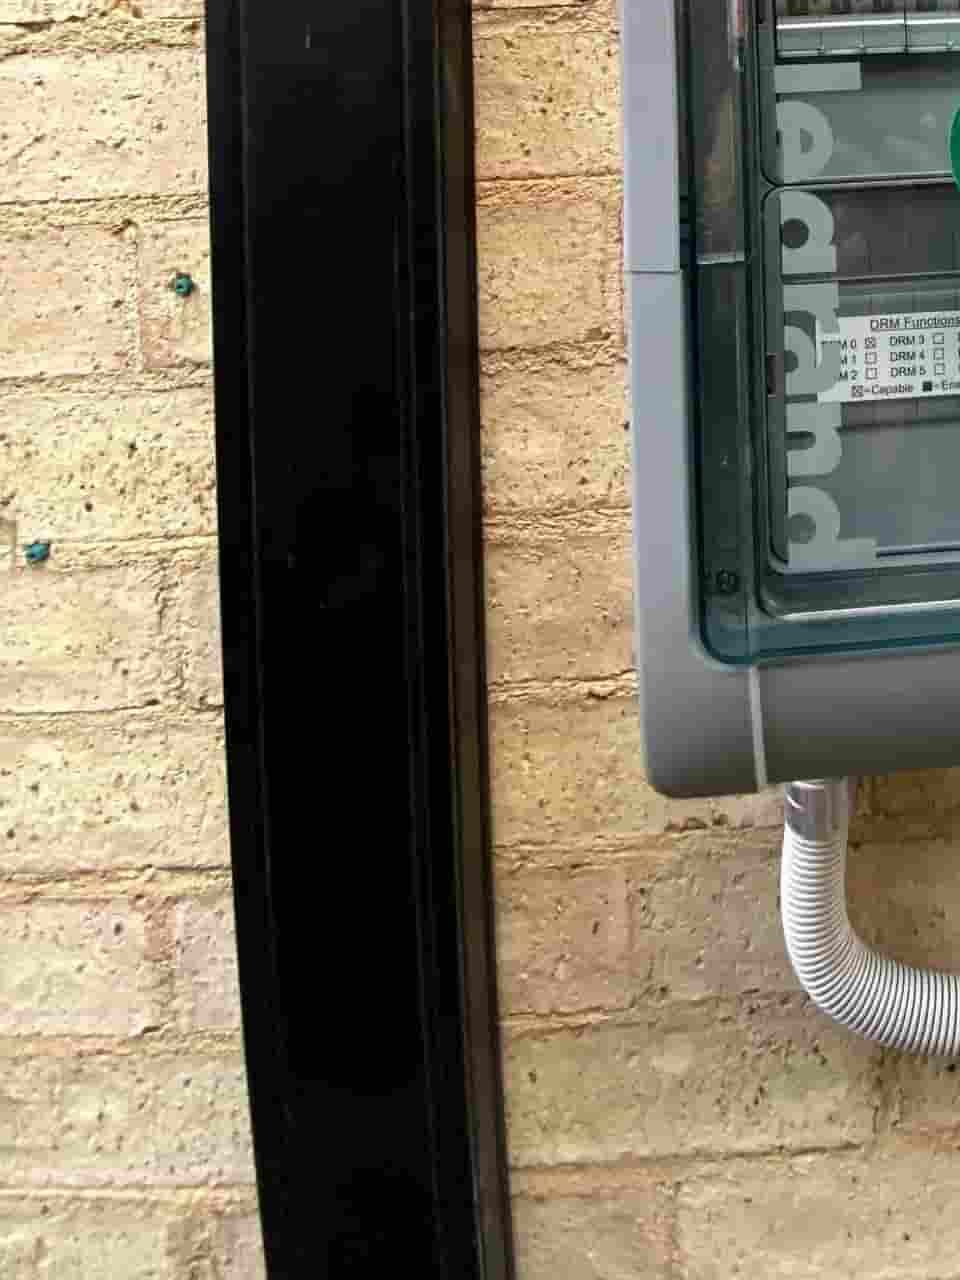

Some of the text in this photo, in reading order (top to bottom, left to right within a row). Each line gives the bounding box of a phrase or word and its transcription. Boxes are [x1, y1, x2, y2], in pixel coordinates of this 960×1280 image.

[870, 316, 960, 329] DRM Functions
[889, 335, 915, 346] DRM
[890, 351, 916, 362] DRM
[890, 366, 916, 378] DRM
